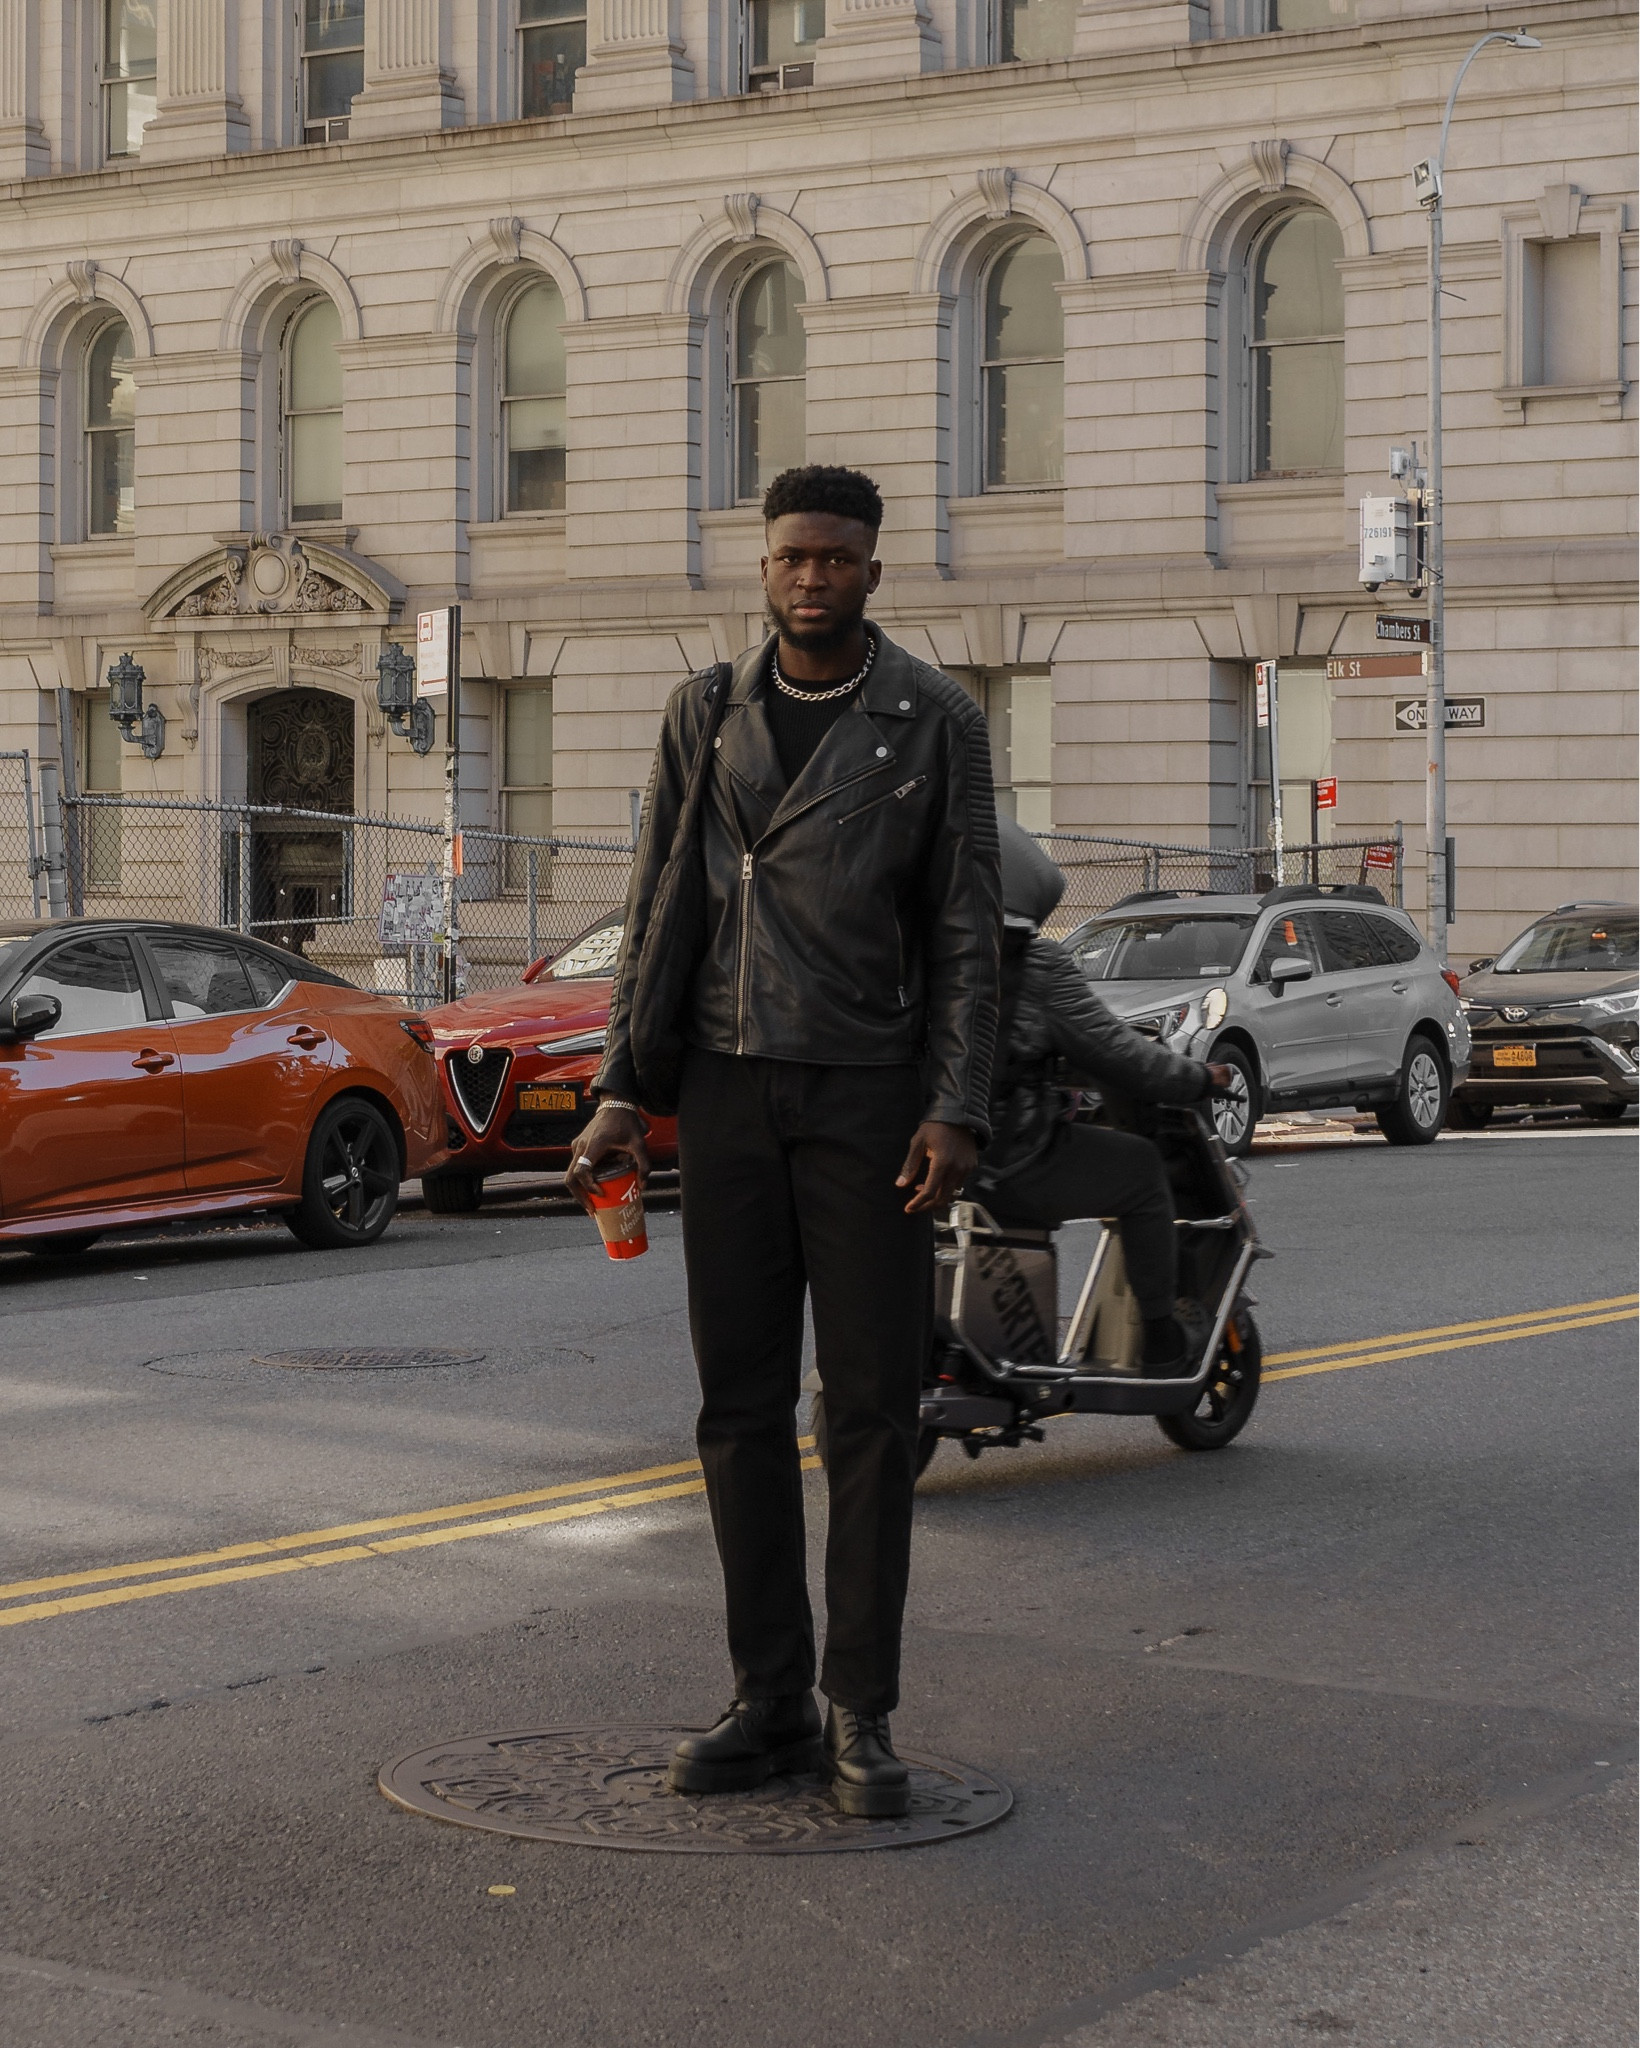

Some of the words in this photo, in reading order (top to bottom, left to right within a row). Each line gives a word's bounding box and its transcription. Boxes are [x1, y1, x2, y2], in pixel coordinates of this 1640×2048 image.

[1363, 527, 1392, 539] 726191
[1376, 621, 1411, 640] Chambers
[1413, 624, 1421, 640] St
[1327, 660, 1344, 677] Elk
[1349, 661, 1361, 677] St
[1449, 707, 1477, 719] WAY
